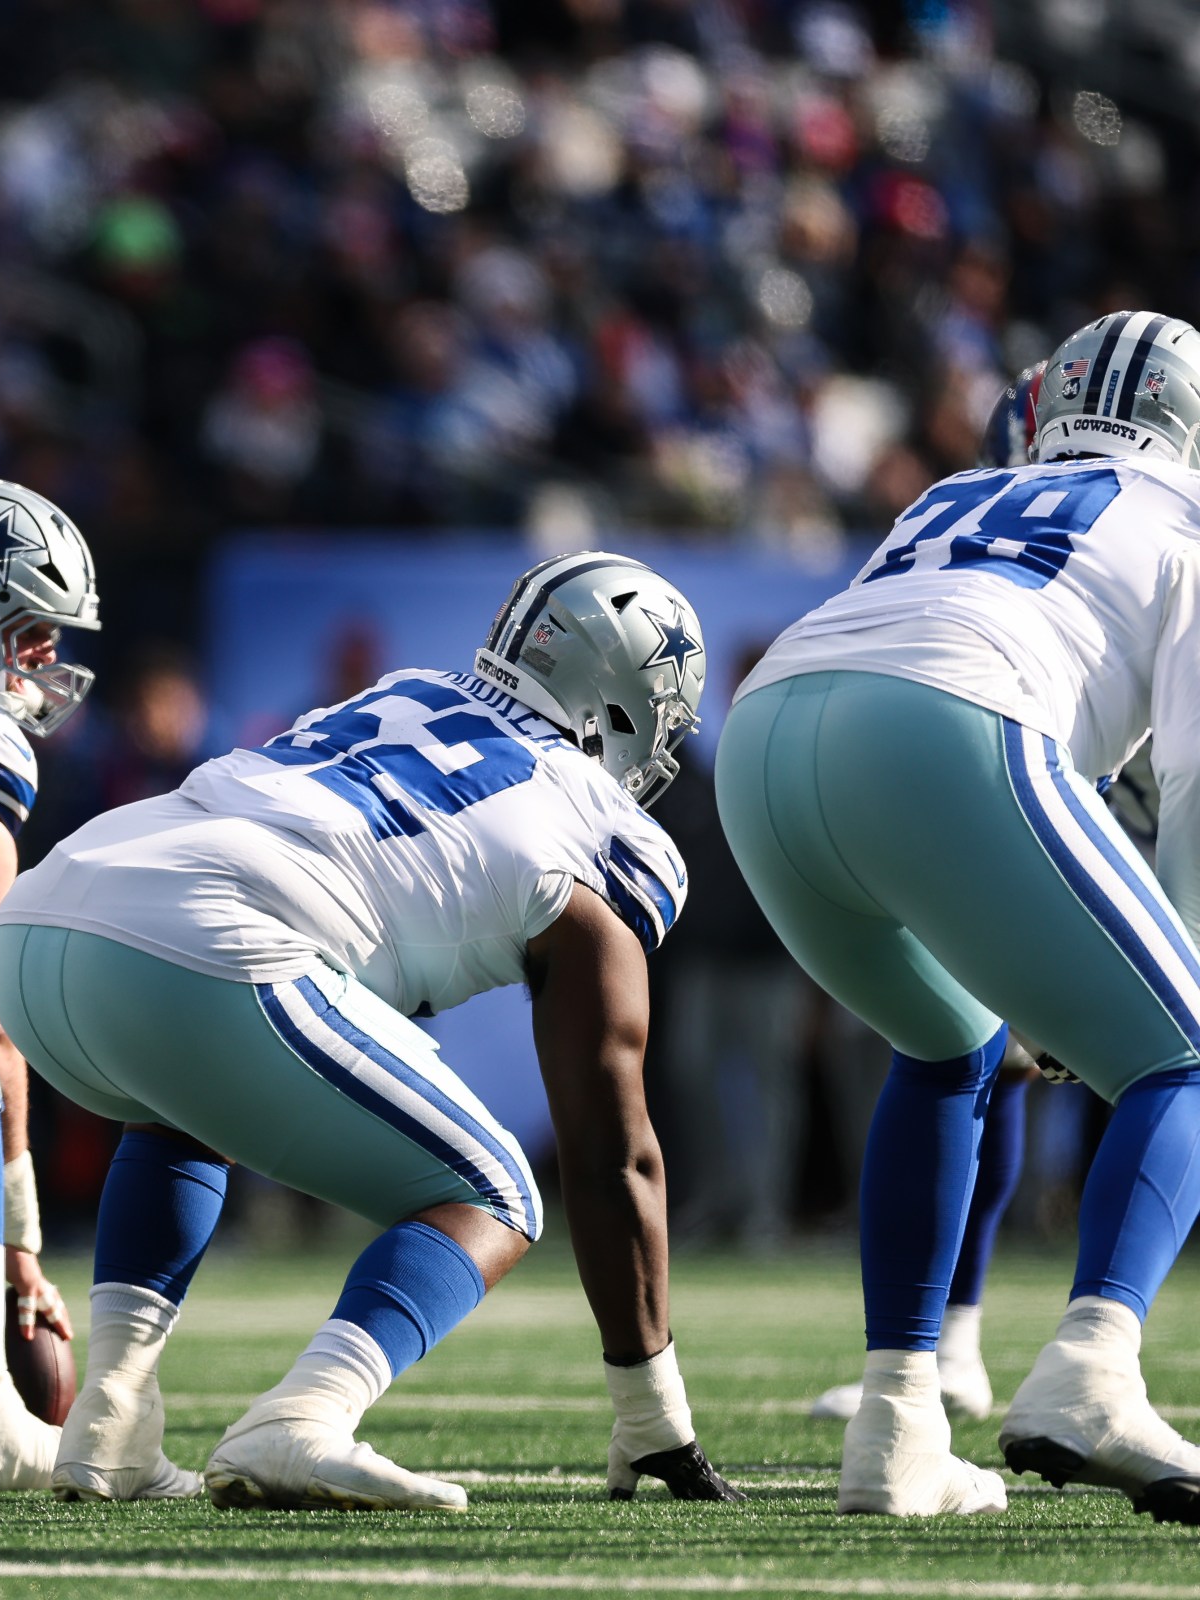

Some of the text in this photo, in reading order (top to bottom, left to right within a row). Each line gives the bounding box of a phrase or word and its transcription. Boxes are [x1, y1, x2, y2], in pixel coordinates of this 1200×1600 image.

[1074, 419, 1137, 440] COWBOYS
[862, 469, 1122, 590] 78
[254, 678, 538, 842] 52
